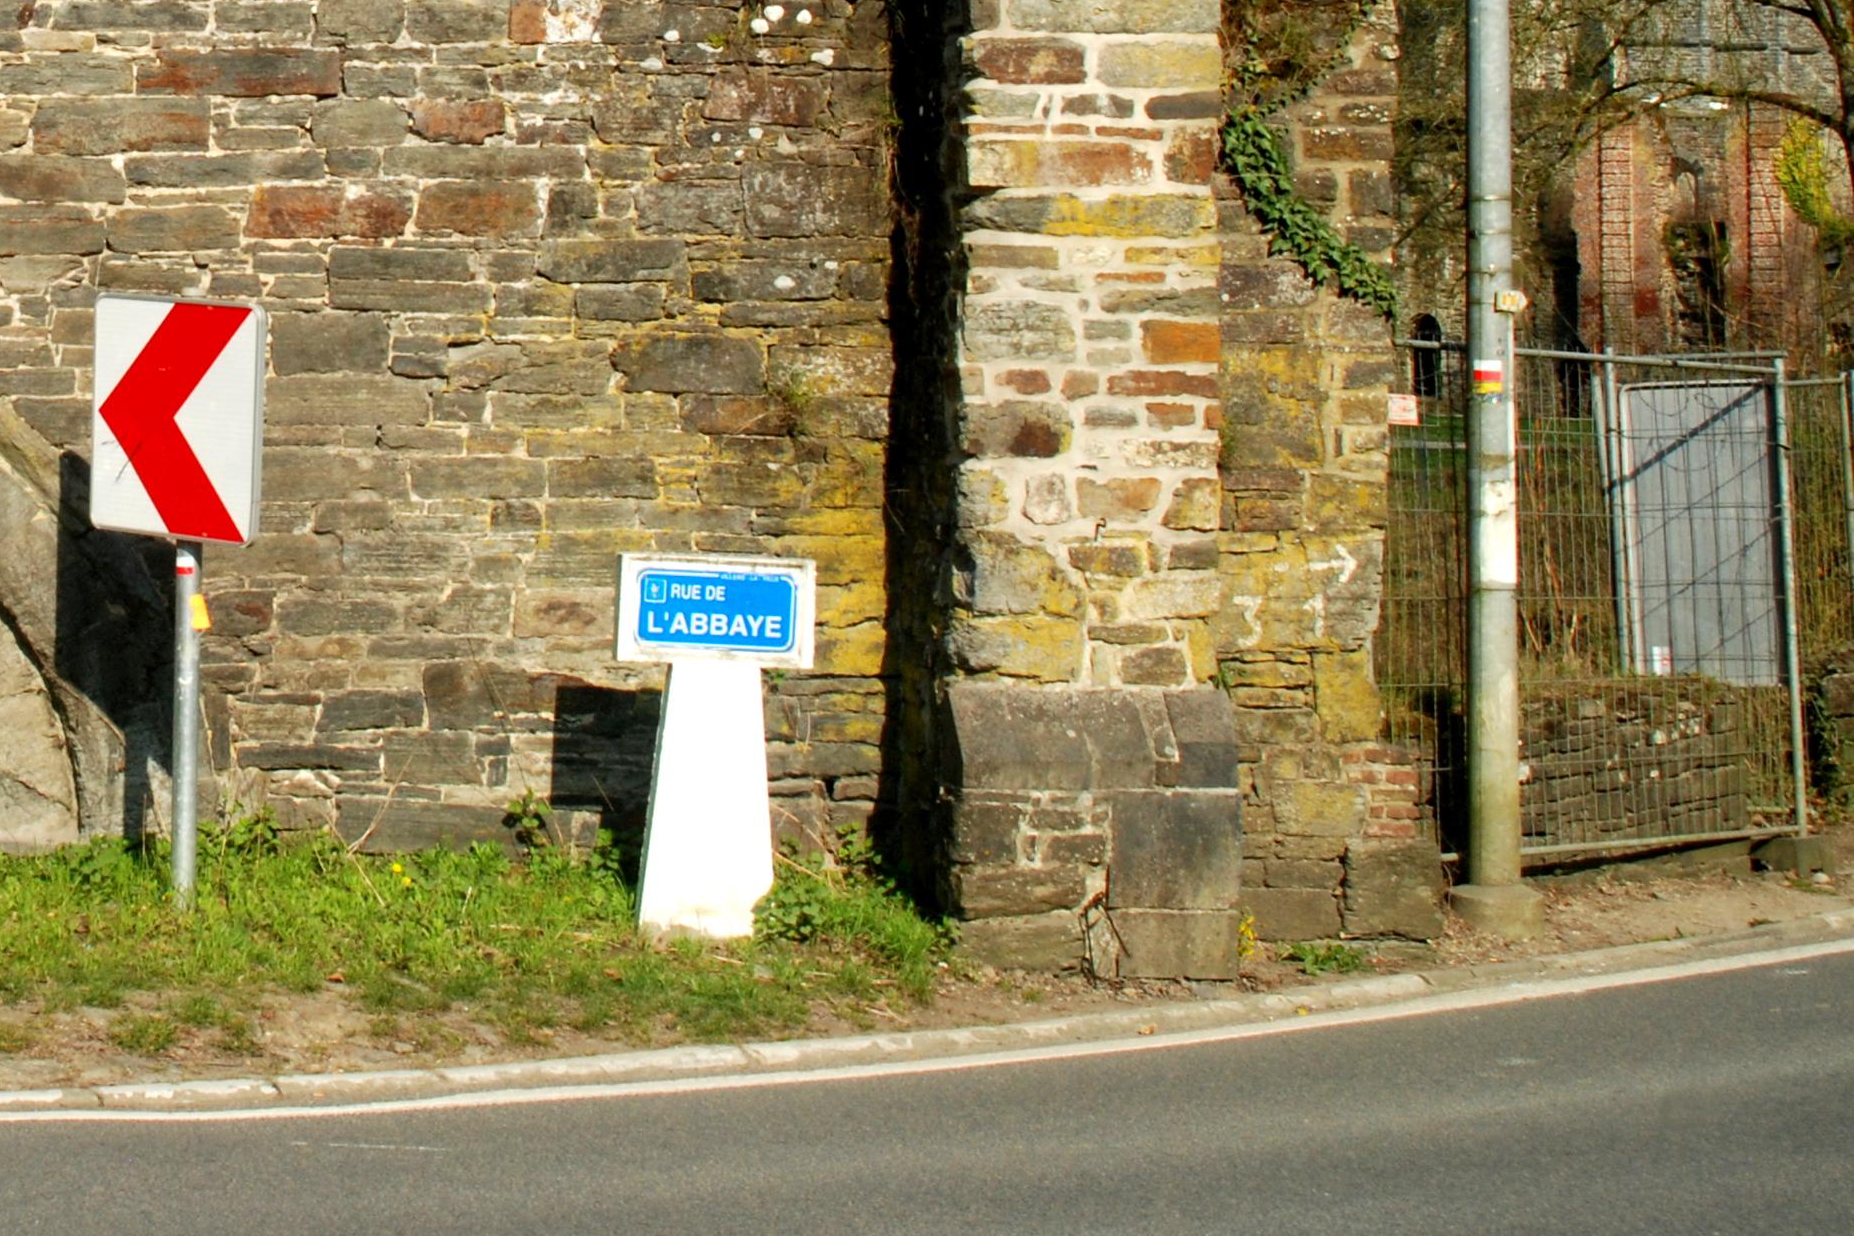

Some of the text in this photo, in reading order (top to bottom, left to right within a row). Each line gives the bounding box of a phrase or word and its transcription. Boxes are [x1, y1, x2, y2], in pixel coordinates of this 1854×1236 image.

[671, 583, 726, 601] RUE DE
[647, 610, 782, 639] L'ABBAYE
